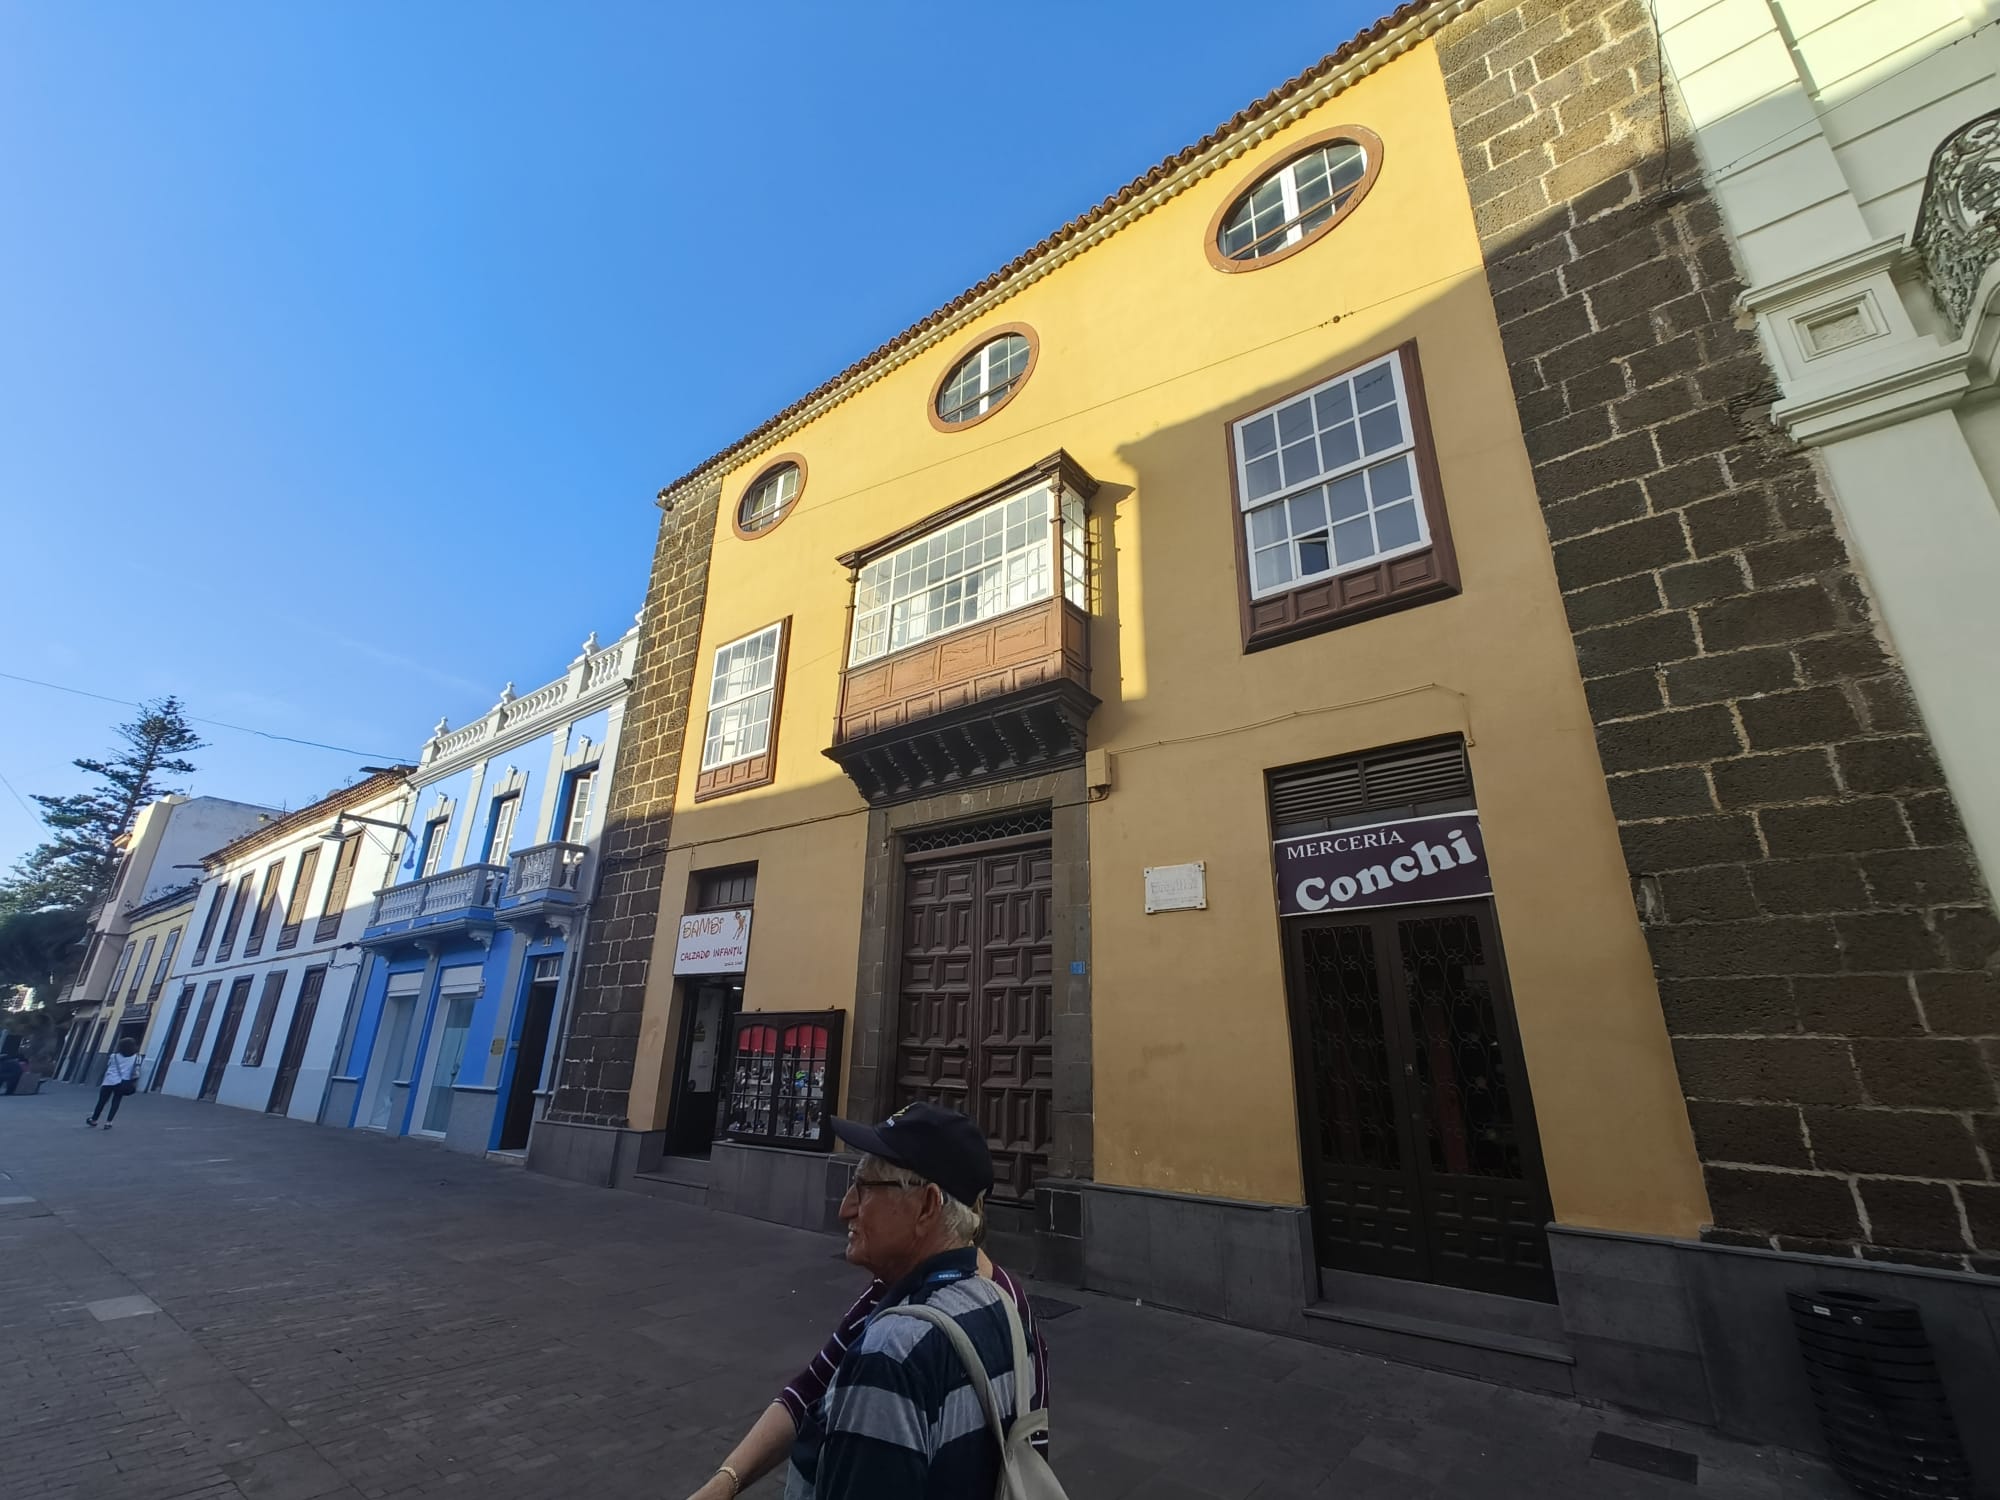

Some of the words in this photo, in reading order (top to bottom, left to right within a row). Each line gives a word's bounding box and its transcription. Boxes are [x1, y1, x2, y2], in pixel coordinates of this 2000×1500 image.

[1287, 829, 1405, 860] MERCERÍA
[1296, 829, 1478, 911] Conchi
[680, 949, 711, 962] CALZADO
[712, 946, 743, 958] INFANTIL
